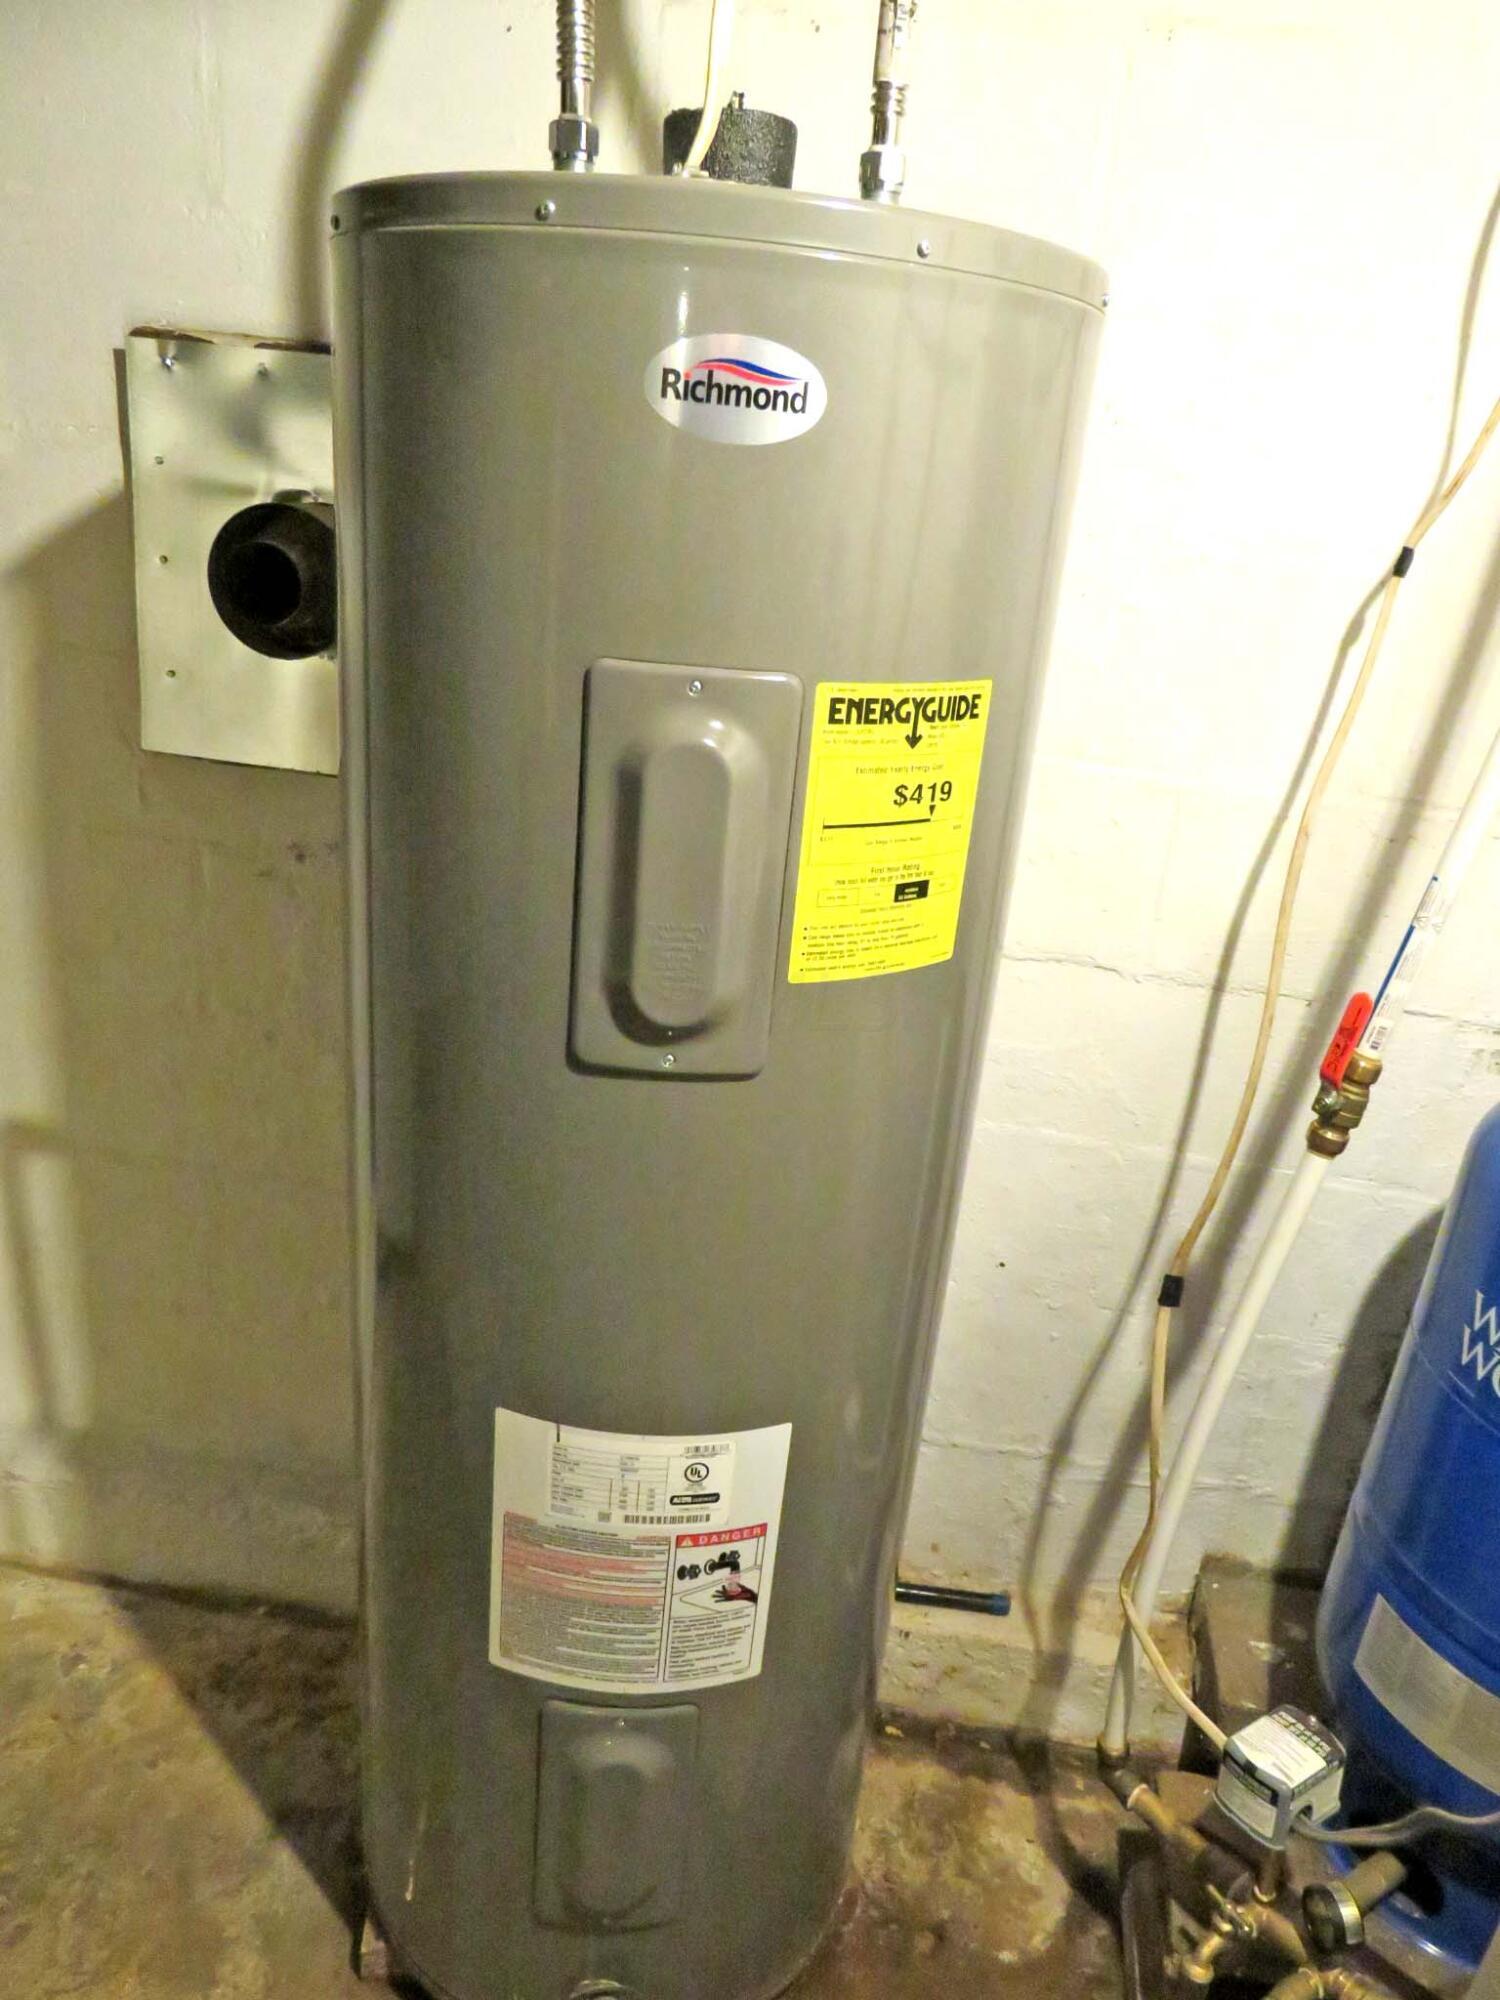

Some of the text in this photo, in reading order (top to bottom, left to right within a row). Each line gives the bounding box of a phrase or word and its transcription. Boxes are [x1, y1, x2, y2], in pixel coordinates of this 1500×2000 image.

[661, 367, 808, 414] Richmond
[828, 694, 981, 736] ENERGYGUIDE
[893, 781, 952, 807] $419
[691, 1467, 702, 1479] UL
[699, 1527, 761, 1545] DANGER
